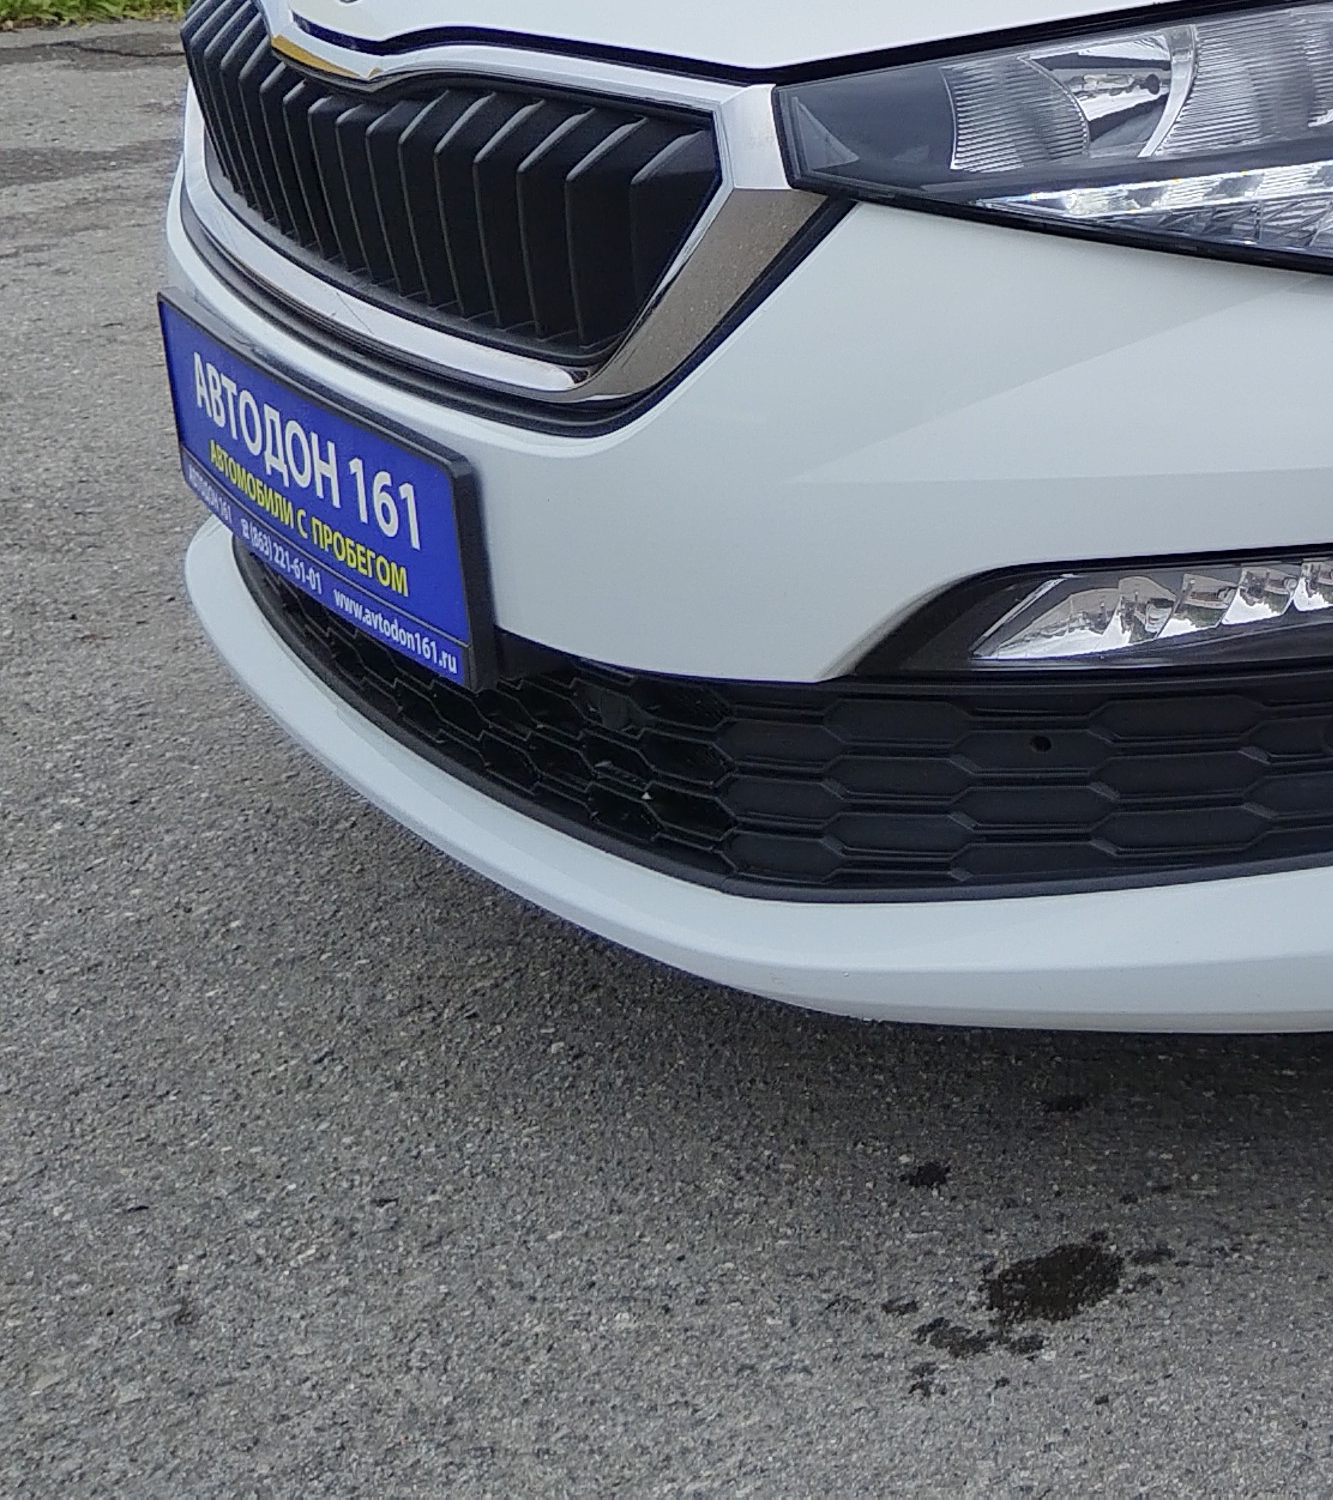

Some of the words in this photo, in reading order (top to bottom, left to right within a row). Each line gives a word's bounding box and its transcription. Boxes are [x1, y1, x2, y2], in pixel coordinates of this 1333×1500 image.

[193, 351, 341, 509] АВТОДОН
[349, 457, 421, 551] 161
[210, 439, 294, 530] АВТОМОБИЛИ
[297, 508, 308, 539] С
[311, 516, 409, 597] ПРОБЕГОМ
[273, 541, 322, 595] 221-61-01
[333, 588, 457, 675] www.avtodon161.ru
